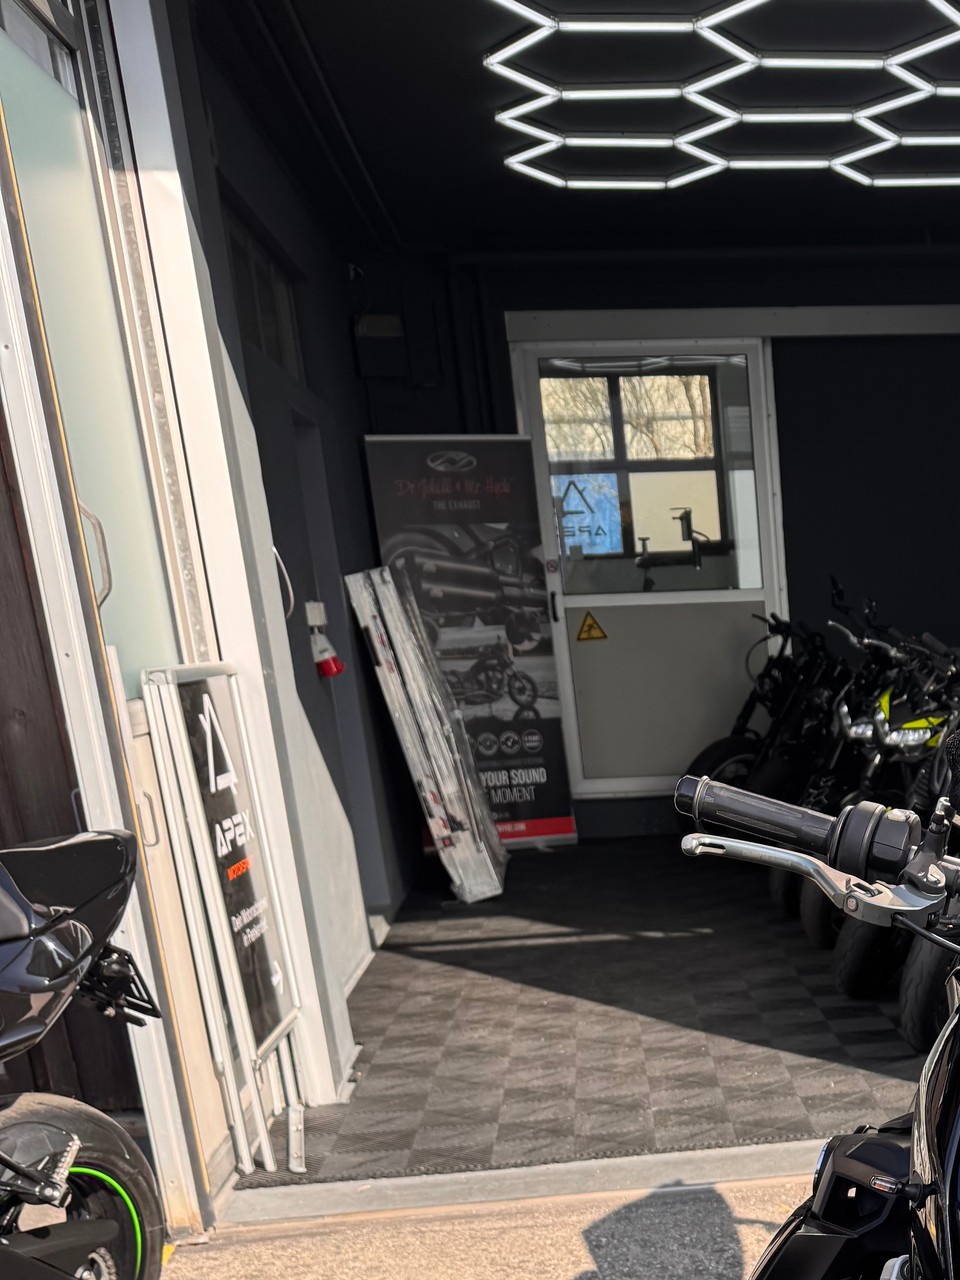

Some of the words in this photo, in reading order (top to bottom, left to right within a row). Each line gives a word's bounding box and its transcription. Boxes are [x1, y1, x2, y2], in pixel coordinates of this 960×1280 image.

[479, 770, 509, 787] YOUR
[509, 767, 547, 784] SOUND
[490, 786, 536, 803] MOMENT
[215, 809, 255, 858] APEX
